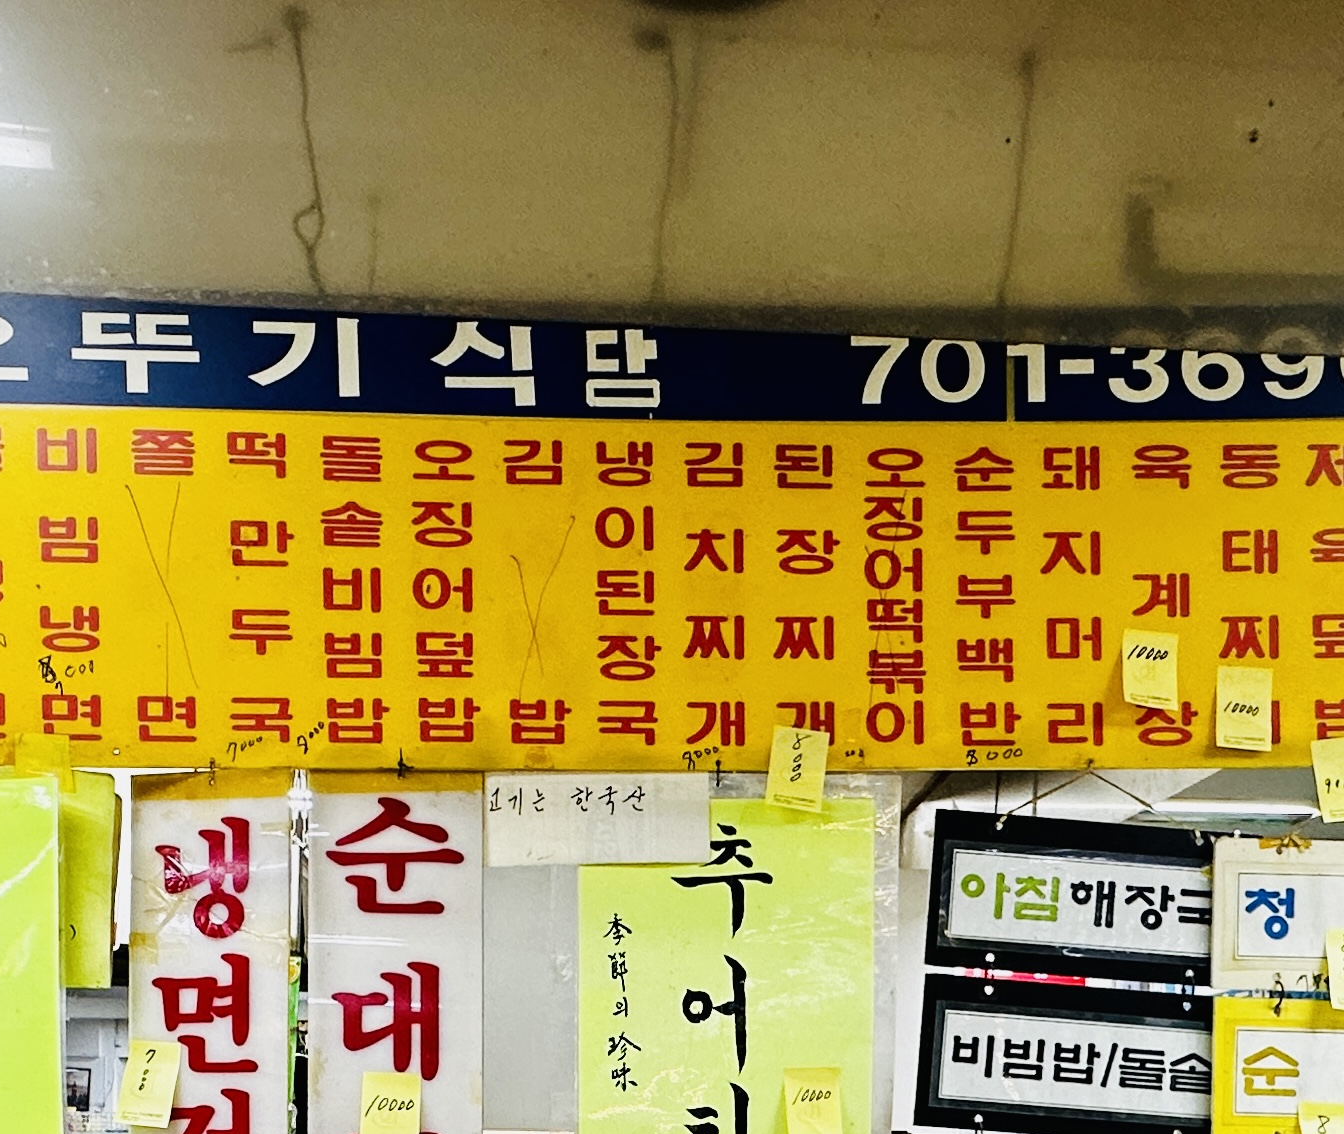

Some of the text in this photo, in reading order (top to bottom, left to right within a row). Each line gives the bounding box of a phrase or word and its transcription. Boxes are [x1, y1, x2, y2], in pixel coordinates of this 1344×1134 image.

[37, 427, 102, 742] 비빔냉면
[131, 429, 197, 742] 쫄면
[226, 431, 295, 744] 떡만두국
[320, 436, 390, 745] 돌솥비빔밥
[412, 440, 481, 743] 오징어덮밥
[504, 440, 572, 745] 김밥
[595, 441, 661, 747] 냉이된장국
[683, 443, 746, 747] 김치찌개
[773, 444, 840, 747] 된장찌개
[863, 447, 927, 746] 오징어떡볶이
[954, 446, 1022, 747] 순두부백반
[1041, 446, 1105, 747] 돼지머리
[1127, 644, 1170, 662] 10000
[1223, 702, 1260, 719] 10000
[570, 785, 646, 816] 한국산
[364, 1095, 415, 1118] 10000
[792, 1088, 833, 1106] 10000
